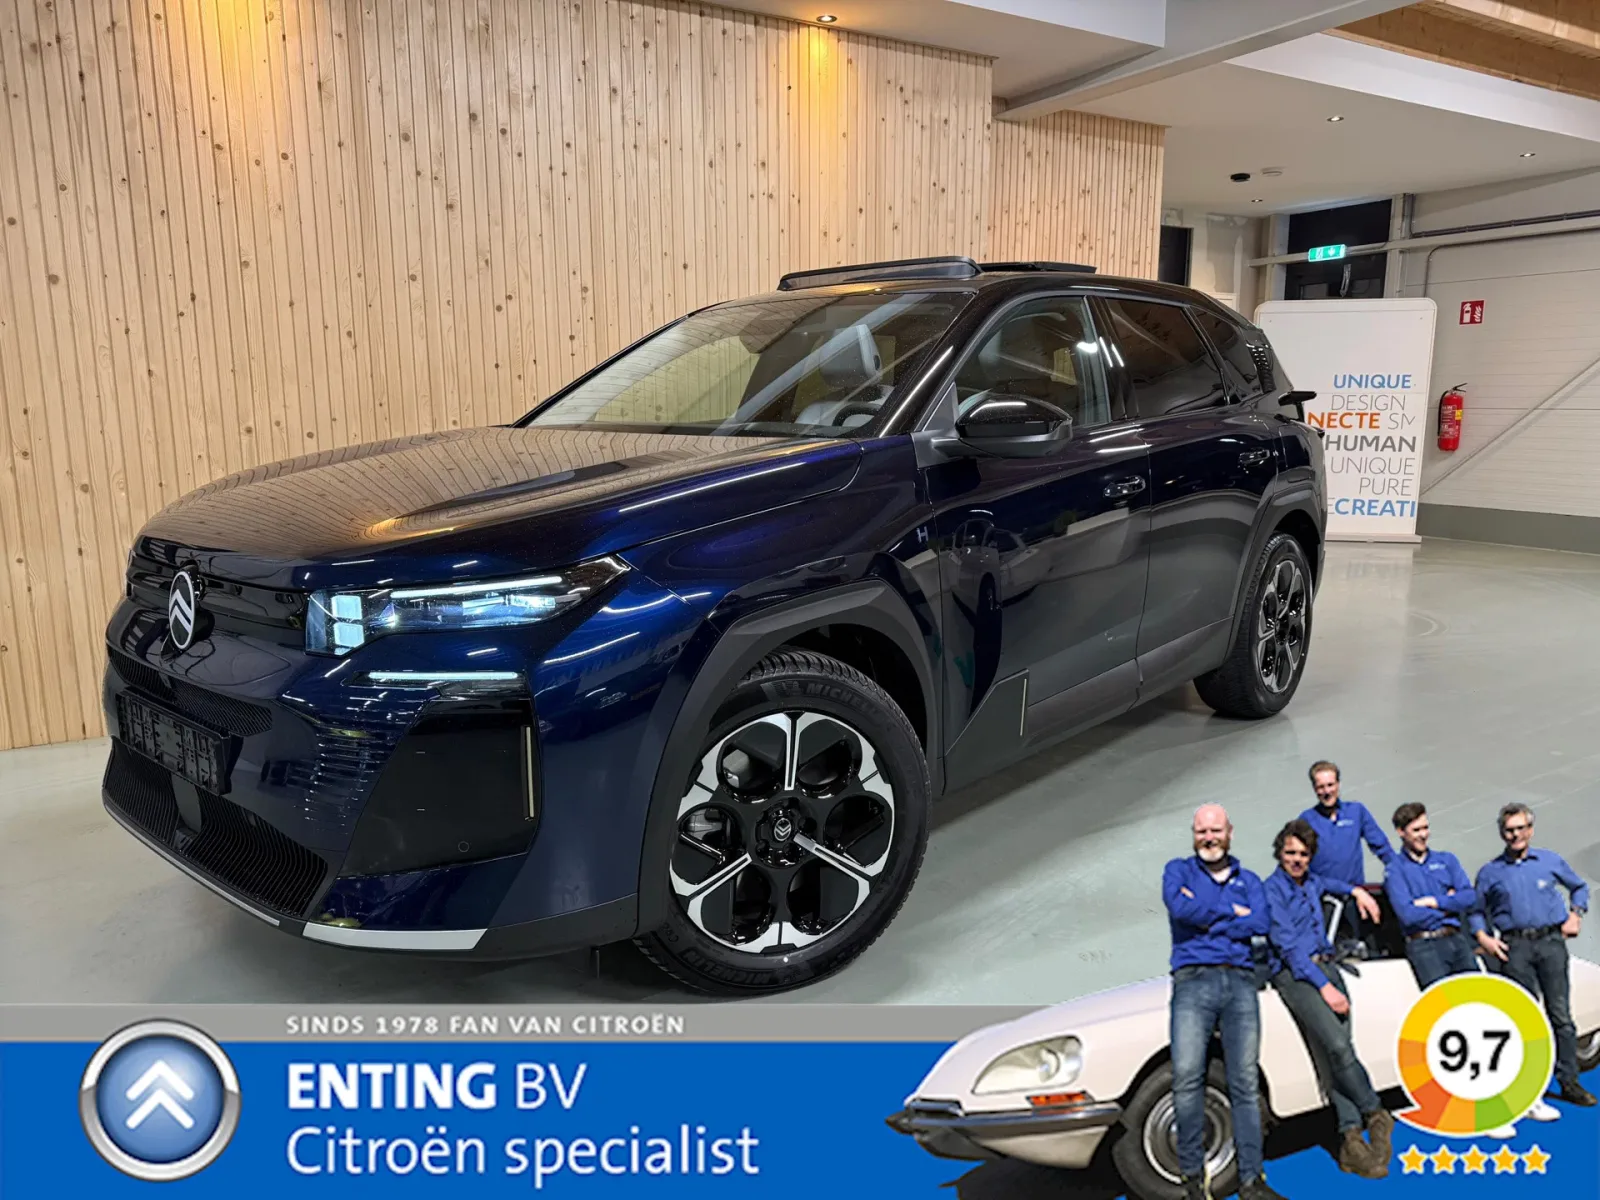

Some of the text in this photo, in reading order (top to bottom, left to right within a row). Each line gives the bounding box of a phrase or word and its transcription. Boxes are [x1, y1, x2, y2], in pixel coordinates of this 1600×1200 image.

[1333, 374, 1412, 389] UNIQUE
[1330, 394, 1406, 412] DESIGN
[1307, 411, 1381, 430] NECTE
[1325, 434, 1417, 453] HUMAN
[1330, 456, 1415, 476] UNIQUE
[1358, 477, 1412, 497] PURE
